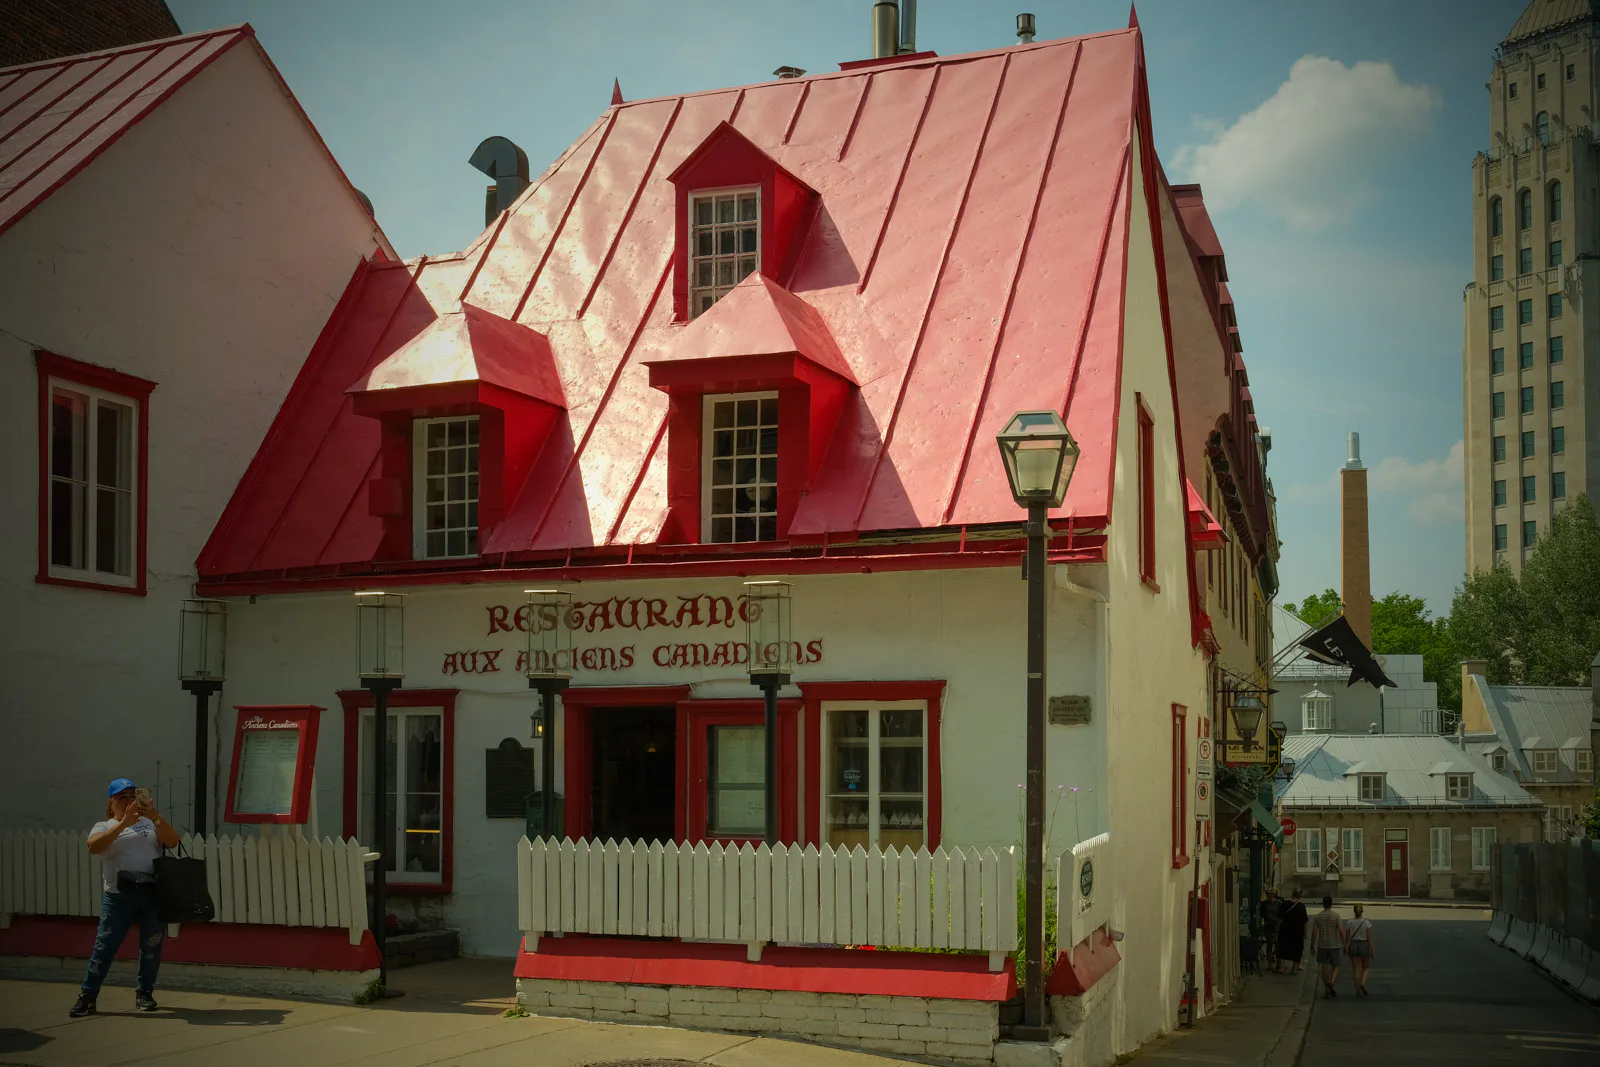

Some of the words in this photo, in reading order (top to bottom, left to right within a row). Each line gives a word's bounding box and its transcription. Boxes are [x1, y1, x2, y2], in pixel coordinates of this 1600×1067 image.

[486, 594, 763, 636] RESTAURANT
[442, 649, 503, 676] AUX
[515, 644, 635, 672] ANCIENS
[652, 638, 823, 668] CANADIENS
